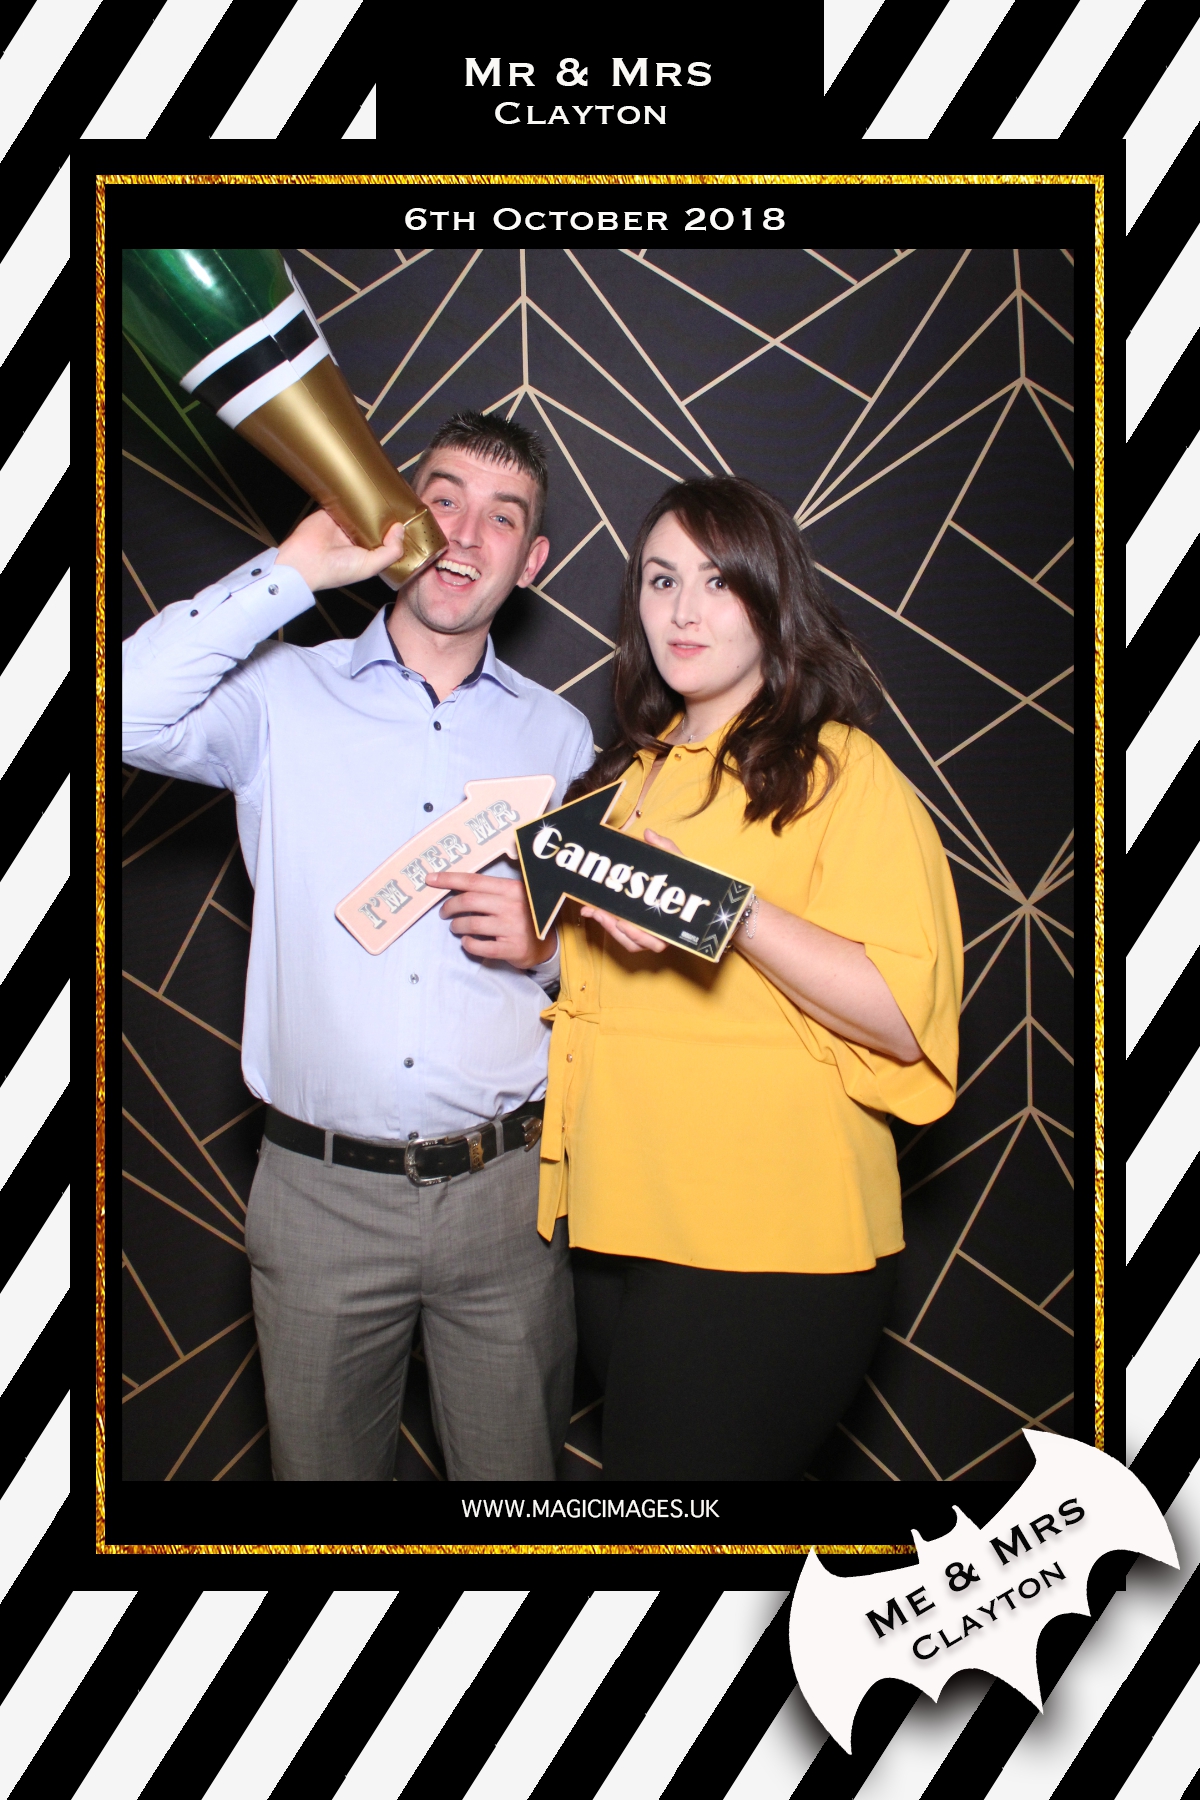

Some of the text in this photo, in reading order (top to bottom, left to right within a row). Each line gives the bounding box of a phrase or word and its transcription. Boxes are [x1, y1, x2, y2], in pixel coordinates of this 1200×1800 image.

[358, 799, 521, 930] I'M HER MR
[532, 825, 711, 923] Gangster
